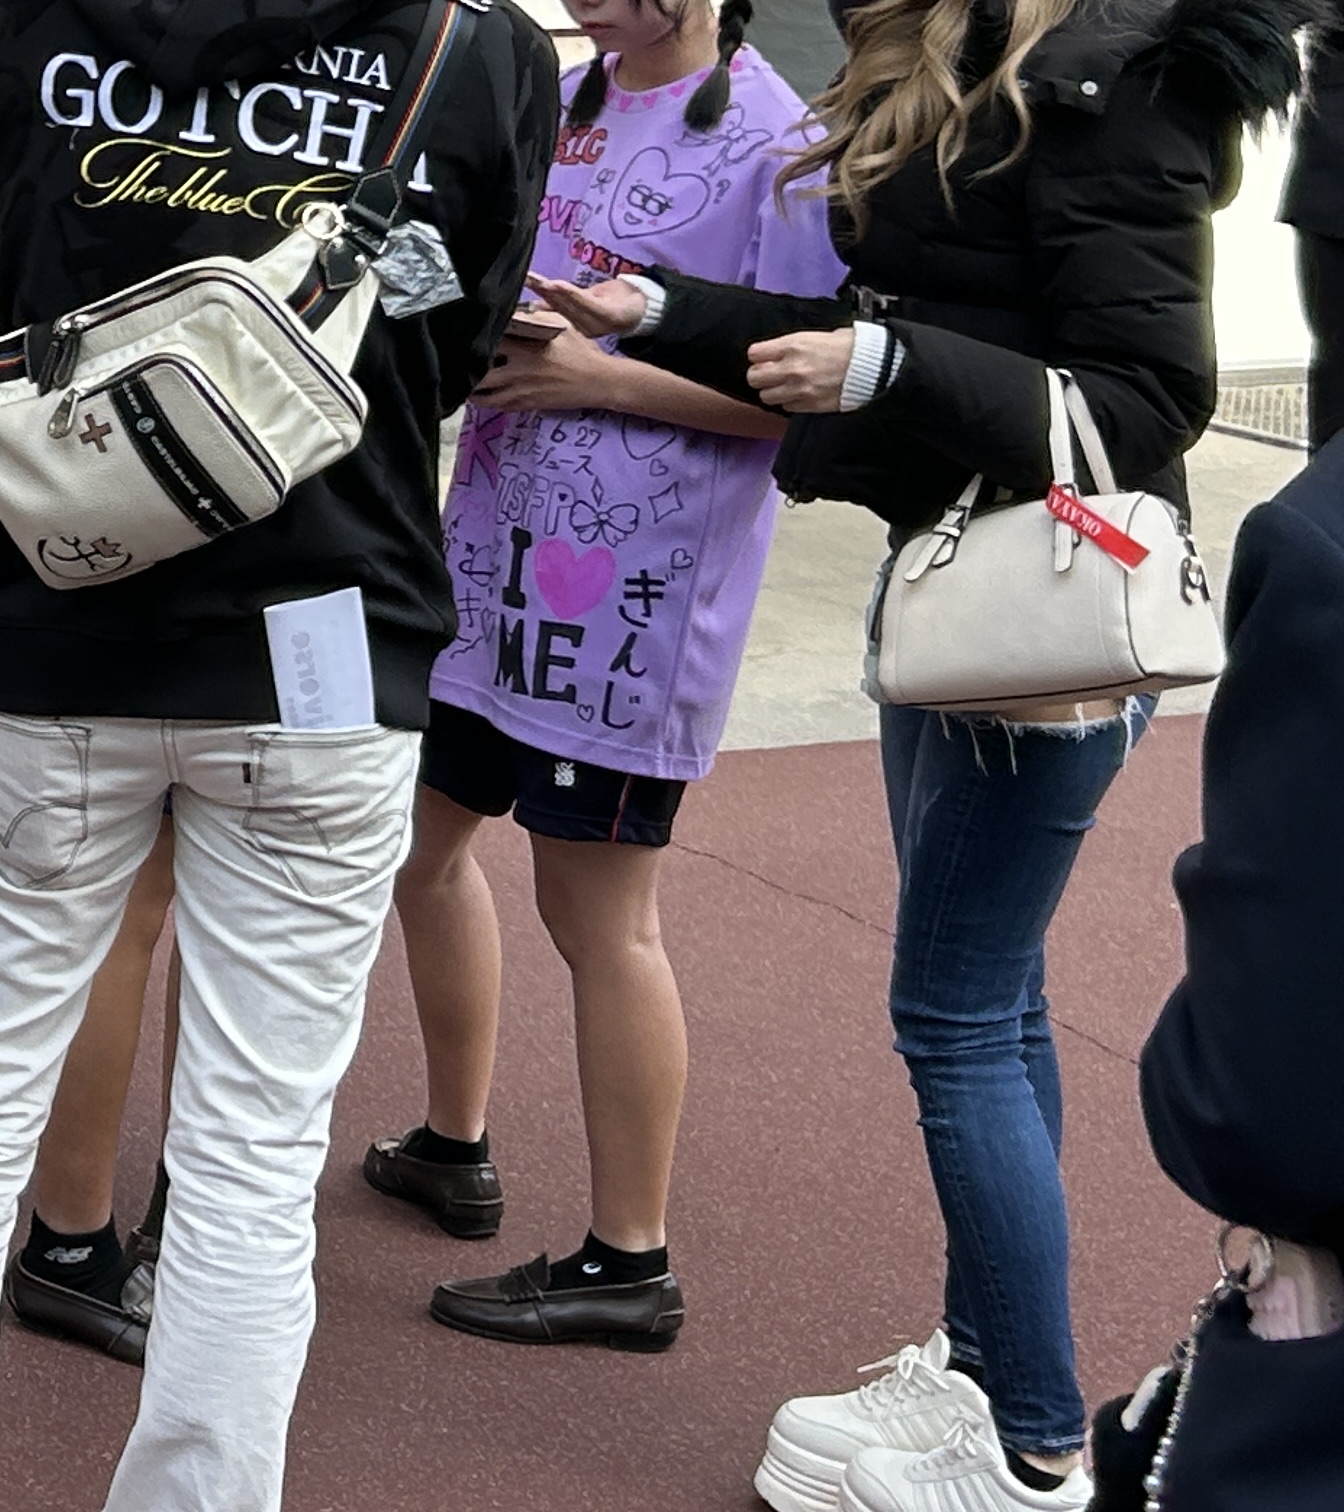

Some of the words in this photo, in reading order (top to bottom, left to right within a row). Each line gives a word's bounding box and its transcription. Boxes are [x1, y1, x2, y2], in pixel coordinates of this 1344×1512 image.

[74, 138, 232, 209] The
[166, 166, 247, 215] blue
[1048, 490, 1103, 538] OKAYA
[493, 620, 585, 705] ME
